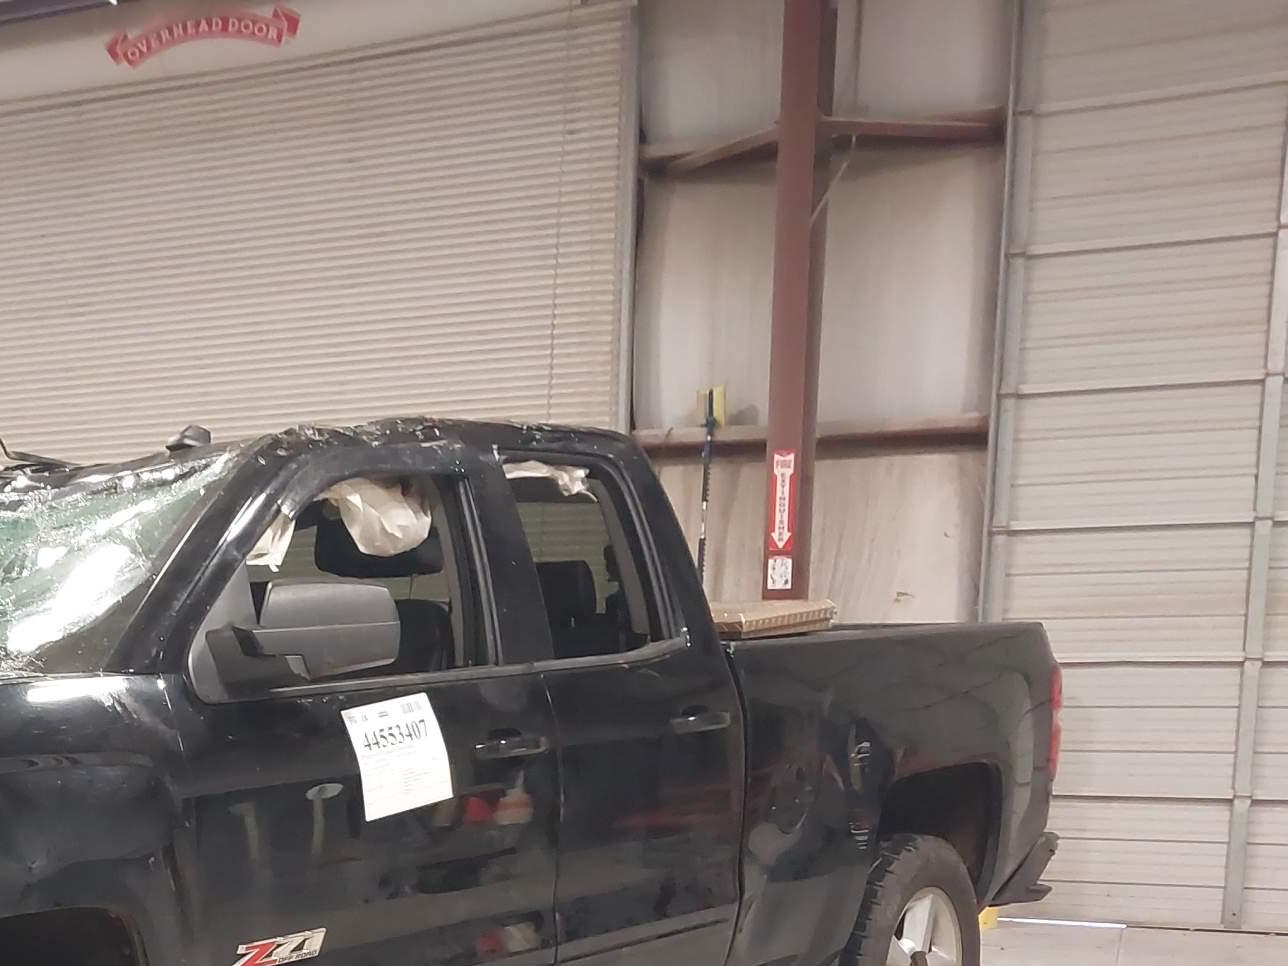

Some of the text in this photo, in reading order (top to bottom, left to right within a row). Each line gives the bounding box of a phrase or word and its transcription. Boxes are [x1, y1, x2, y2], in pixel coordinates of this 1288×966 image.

[127, 17, 278, 61] OVERHEAD DOOR
[363, 718, 428, 751] 44553407
